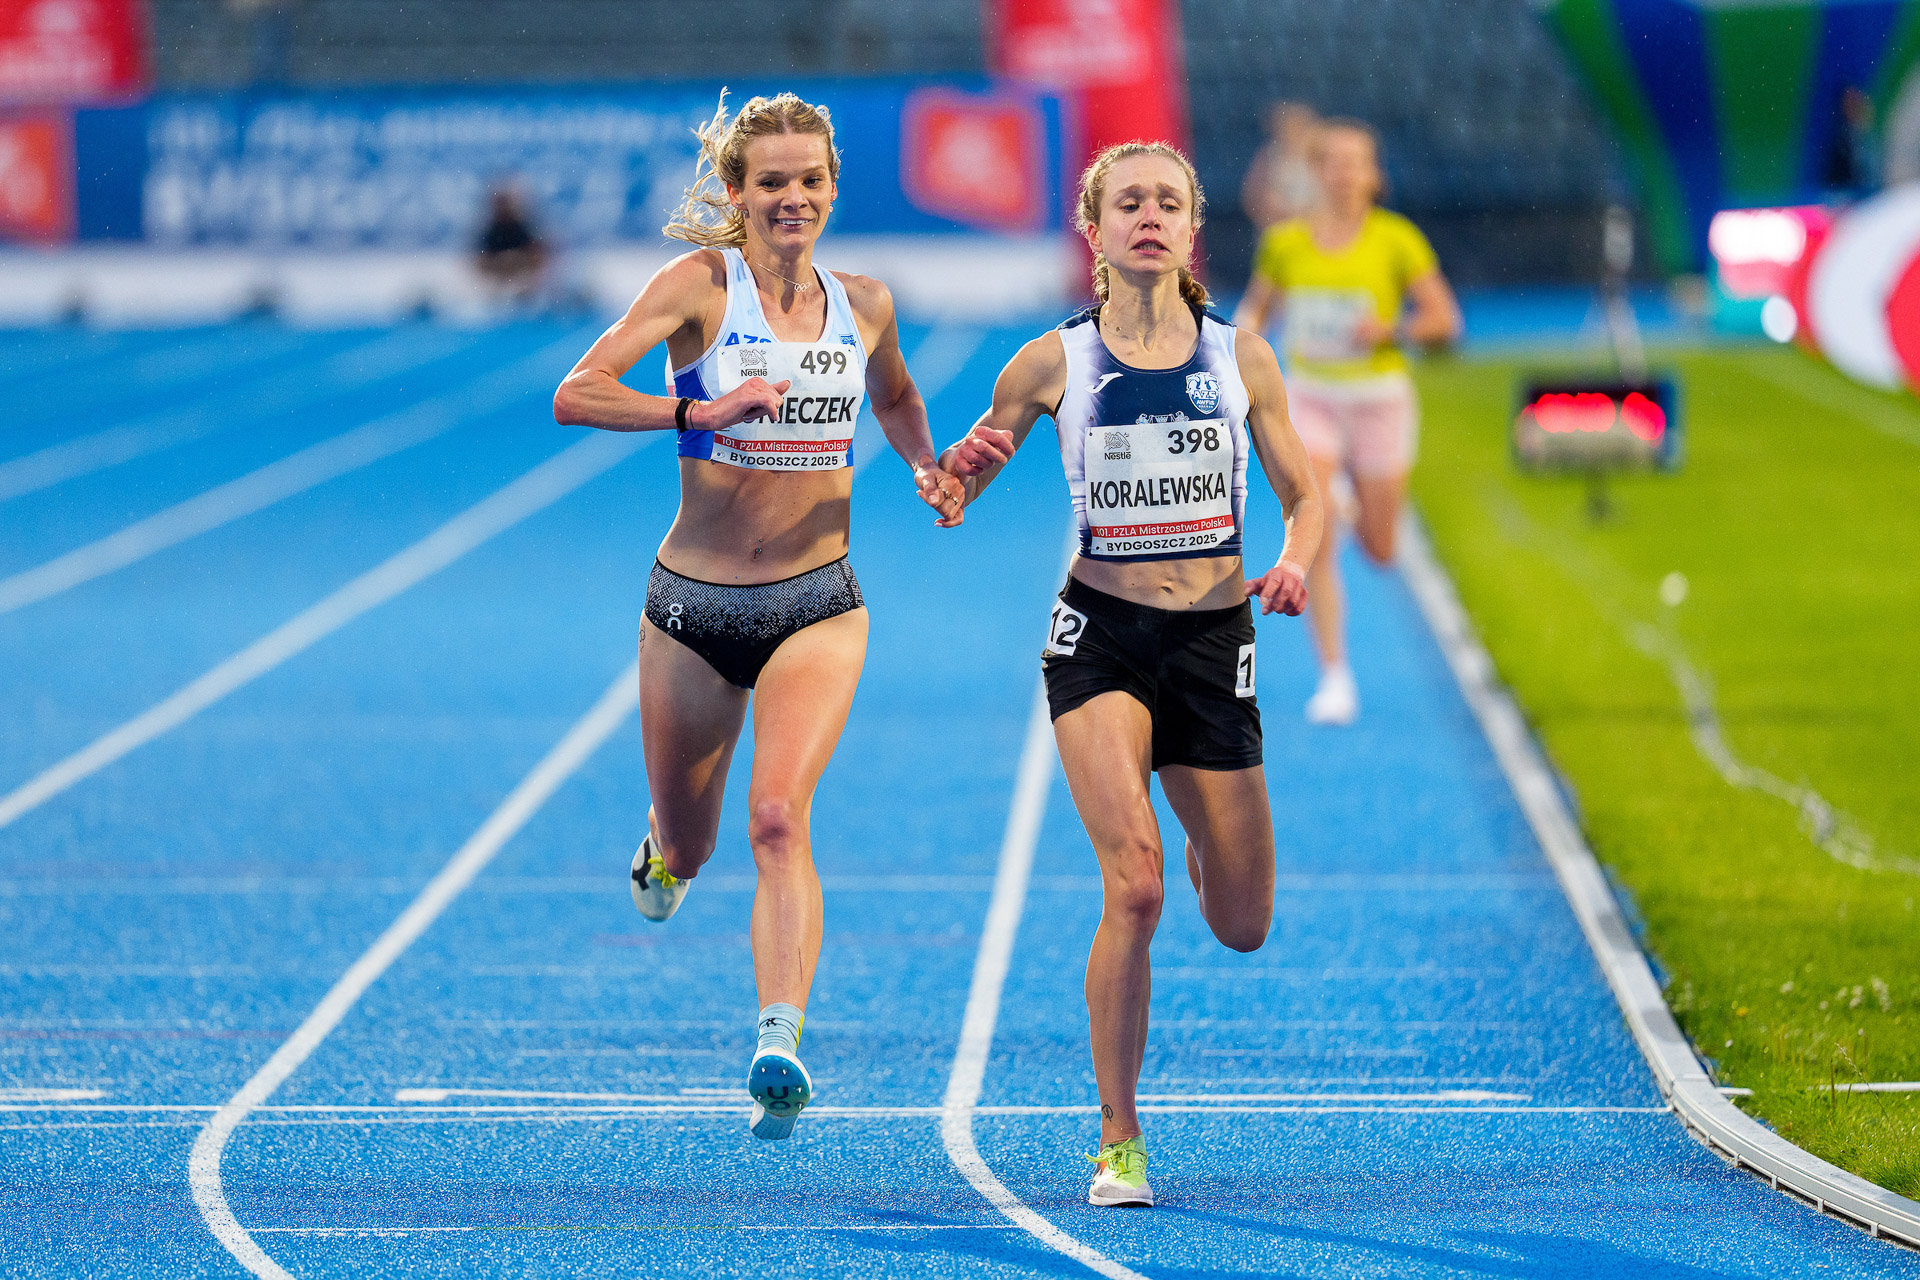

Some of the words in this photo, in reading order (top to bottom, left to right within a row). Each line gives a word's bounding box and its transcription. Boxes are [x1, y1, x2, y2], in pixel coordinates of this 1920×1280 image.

[800, 350, 847, 375] 499
[1193, 390, 1217, 400] AZS
[743, 396, 856, 424] IECZEK
[722, 437, 737, 449] 101.
[740, 442, 762, 451] PZLA
[764, 442, 822, 452] Mistrzostwa
[823, 441, 848, 451] Polski
[1167, 427, 1220, 455] 398
[730, 451, 808, 467] BYDGOSZCZ
[810, 456, 838, 466] 2025
[1090, 472, 1227, 510] KORALEWSKA
[1096, 527, 1111, 537] 101.
[1113, 527, 1137, 537] PZLA
[1139, 524, 1199, 535] Mistrzostwa
[1200, 517, 1226, 530] Polski
[1106, 537, 1187, 552] BYDGOSZCZ
[1188, 533, 1218, 547] 2025
[1051, 607, 1082, 648] 12
[1239, 653, 1255, 688] 1
